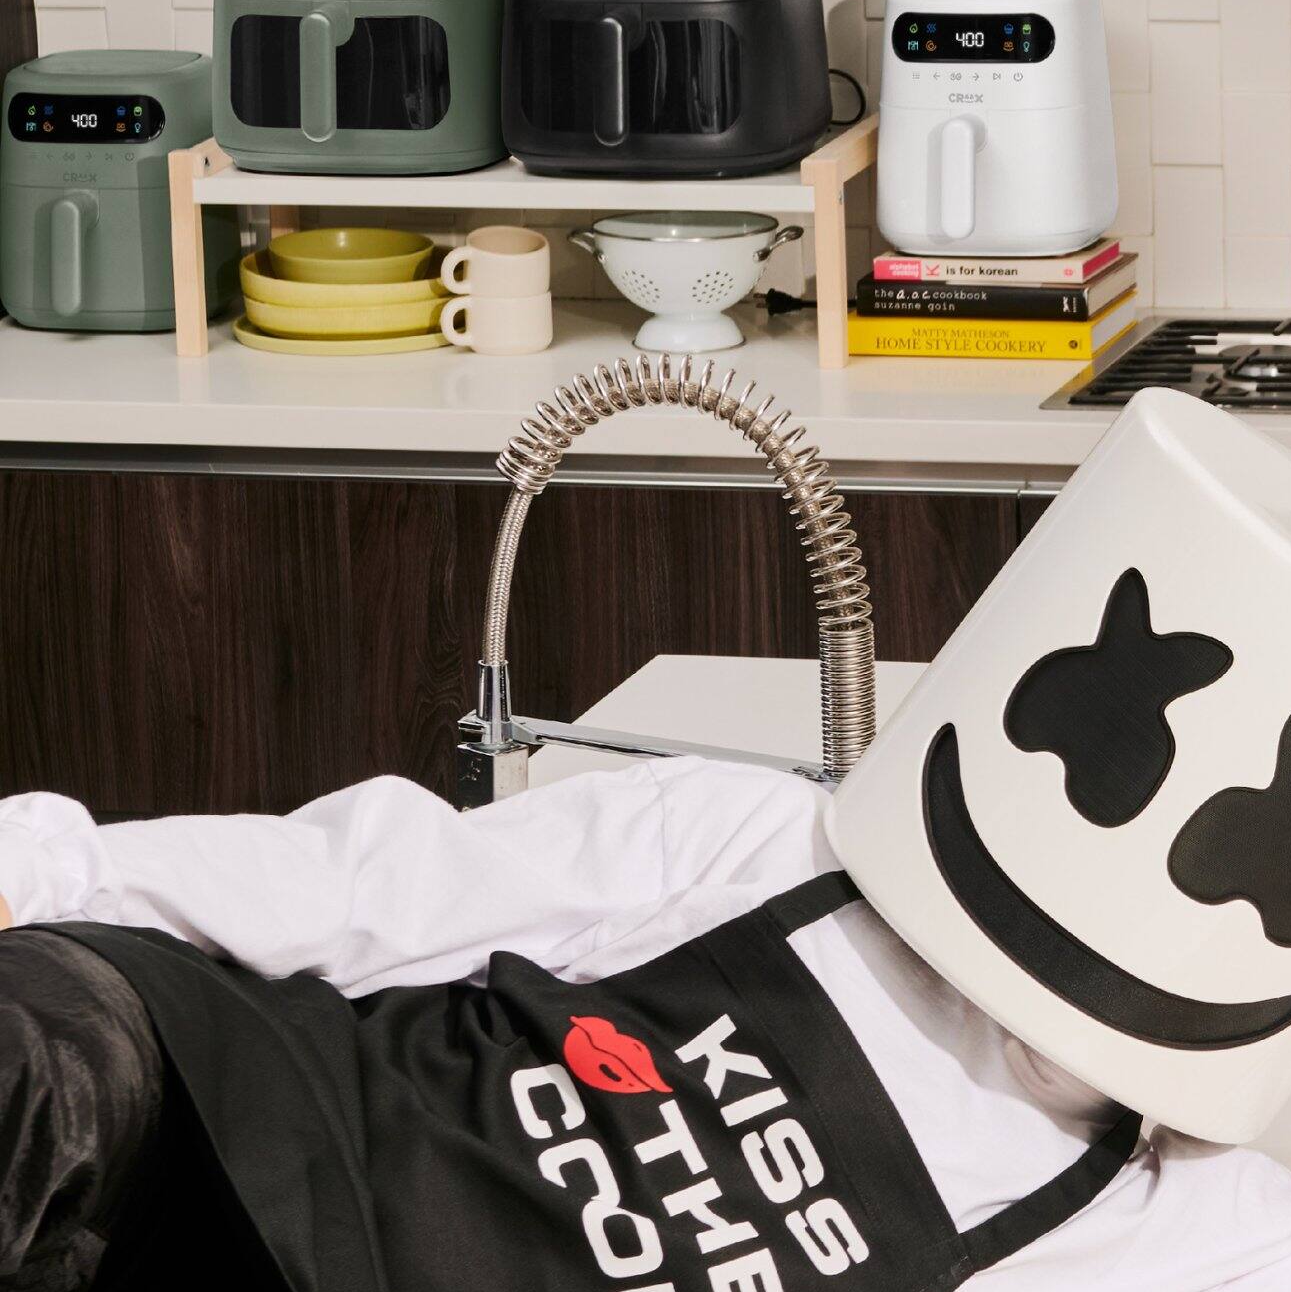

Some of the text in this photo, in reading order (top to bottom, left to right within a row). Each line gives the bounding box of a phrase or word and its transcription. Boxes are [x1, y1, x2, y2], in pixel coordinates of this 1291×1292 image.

[955, 32, 984, 48] 400
[71, 113, 98, 128] 400
[945, 265, 955, 276] is
[959, 264, 976, 276] for
[978, 264, 1019, 277] korean
[874, 288, 895, 299] the
[932, 290, 988, 302] cookbook
[874, 302, 956, 312] suzanne goin
[911, 327, 1010, 339] MATTY MATHESON
[875, 336, 1047, 353] HOME STYLE COOKERY
[674, 1013, 871, 1276] KISS
